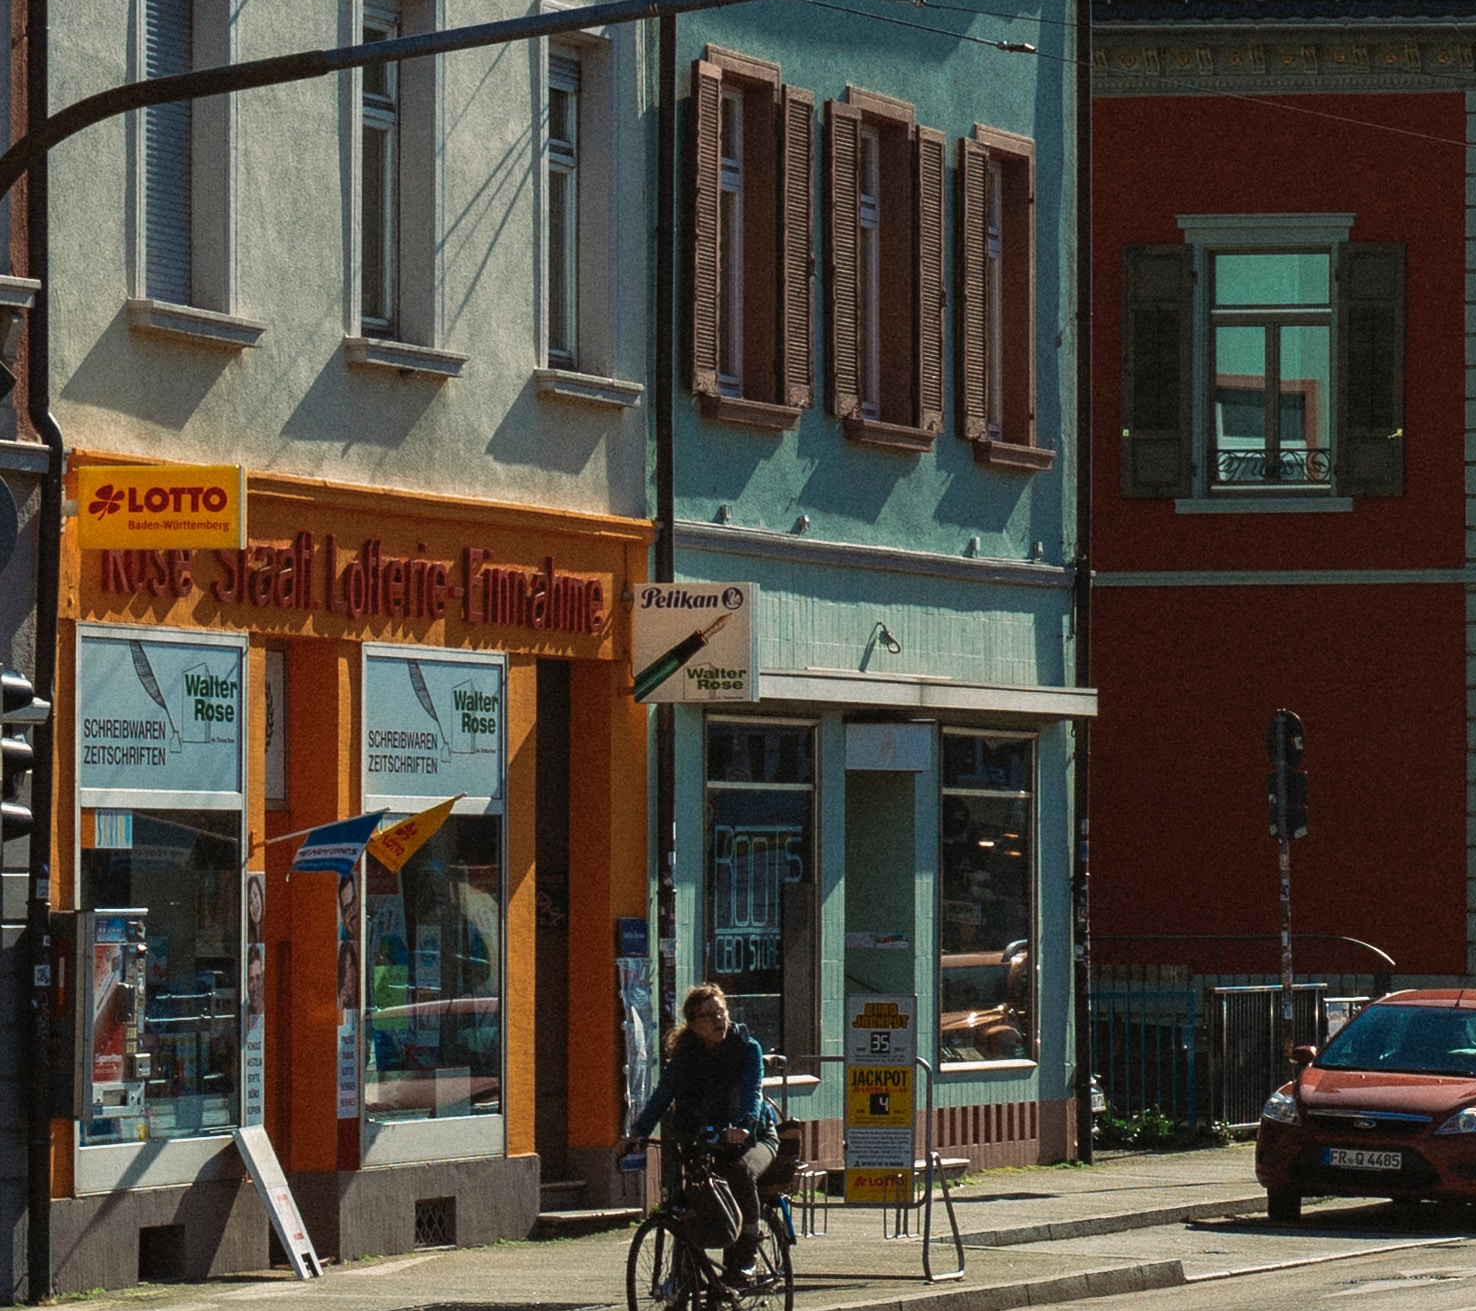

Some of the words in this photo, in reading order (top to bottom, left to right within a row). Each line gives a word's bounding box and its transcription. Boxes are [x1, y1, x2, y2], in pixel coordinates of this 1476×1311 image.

[128, 487, 227, 513] LOTTO
[128, 519, 230, 533] Baden-Württemberg
[641, 587, 719, 610] Pelikan
[686, 668, 747, 679] Walter
[185, 674, 238, 699] Walter
[697, 679, 744, 690] Rose
[194, 698, 235, 723] Rose
[453, 690, 499, 713] Walter
[83, 719, 166, 740] SCHREIBWAREN
[461, 712, 496, 735] Rose
[368, 730, 438, 750] SCHREIBWAREN
[83, 745, 166, 766] ZEITSCHRIFTEN
[368, 755, 438, 774] ZEITSCHRIFTEN
[311, 846, 360, 857] Hermes
[715, 936, 744, 973] CBD
[749, 936, 781, 971] STORE
[864, 1002, 900, 1016] EURO
[852, 1013, 911, 1029] JACKPOT
[871, 1033, 890, 1053] 35
[851, 1070, 909, 1088] JACKPOT
[1330, 1152, 1346, 1165] FR
[1355, 1153, 1364, 1166] Q
[1367, 1154, 1400, 1168] 4485
